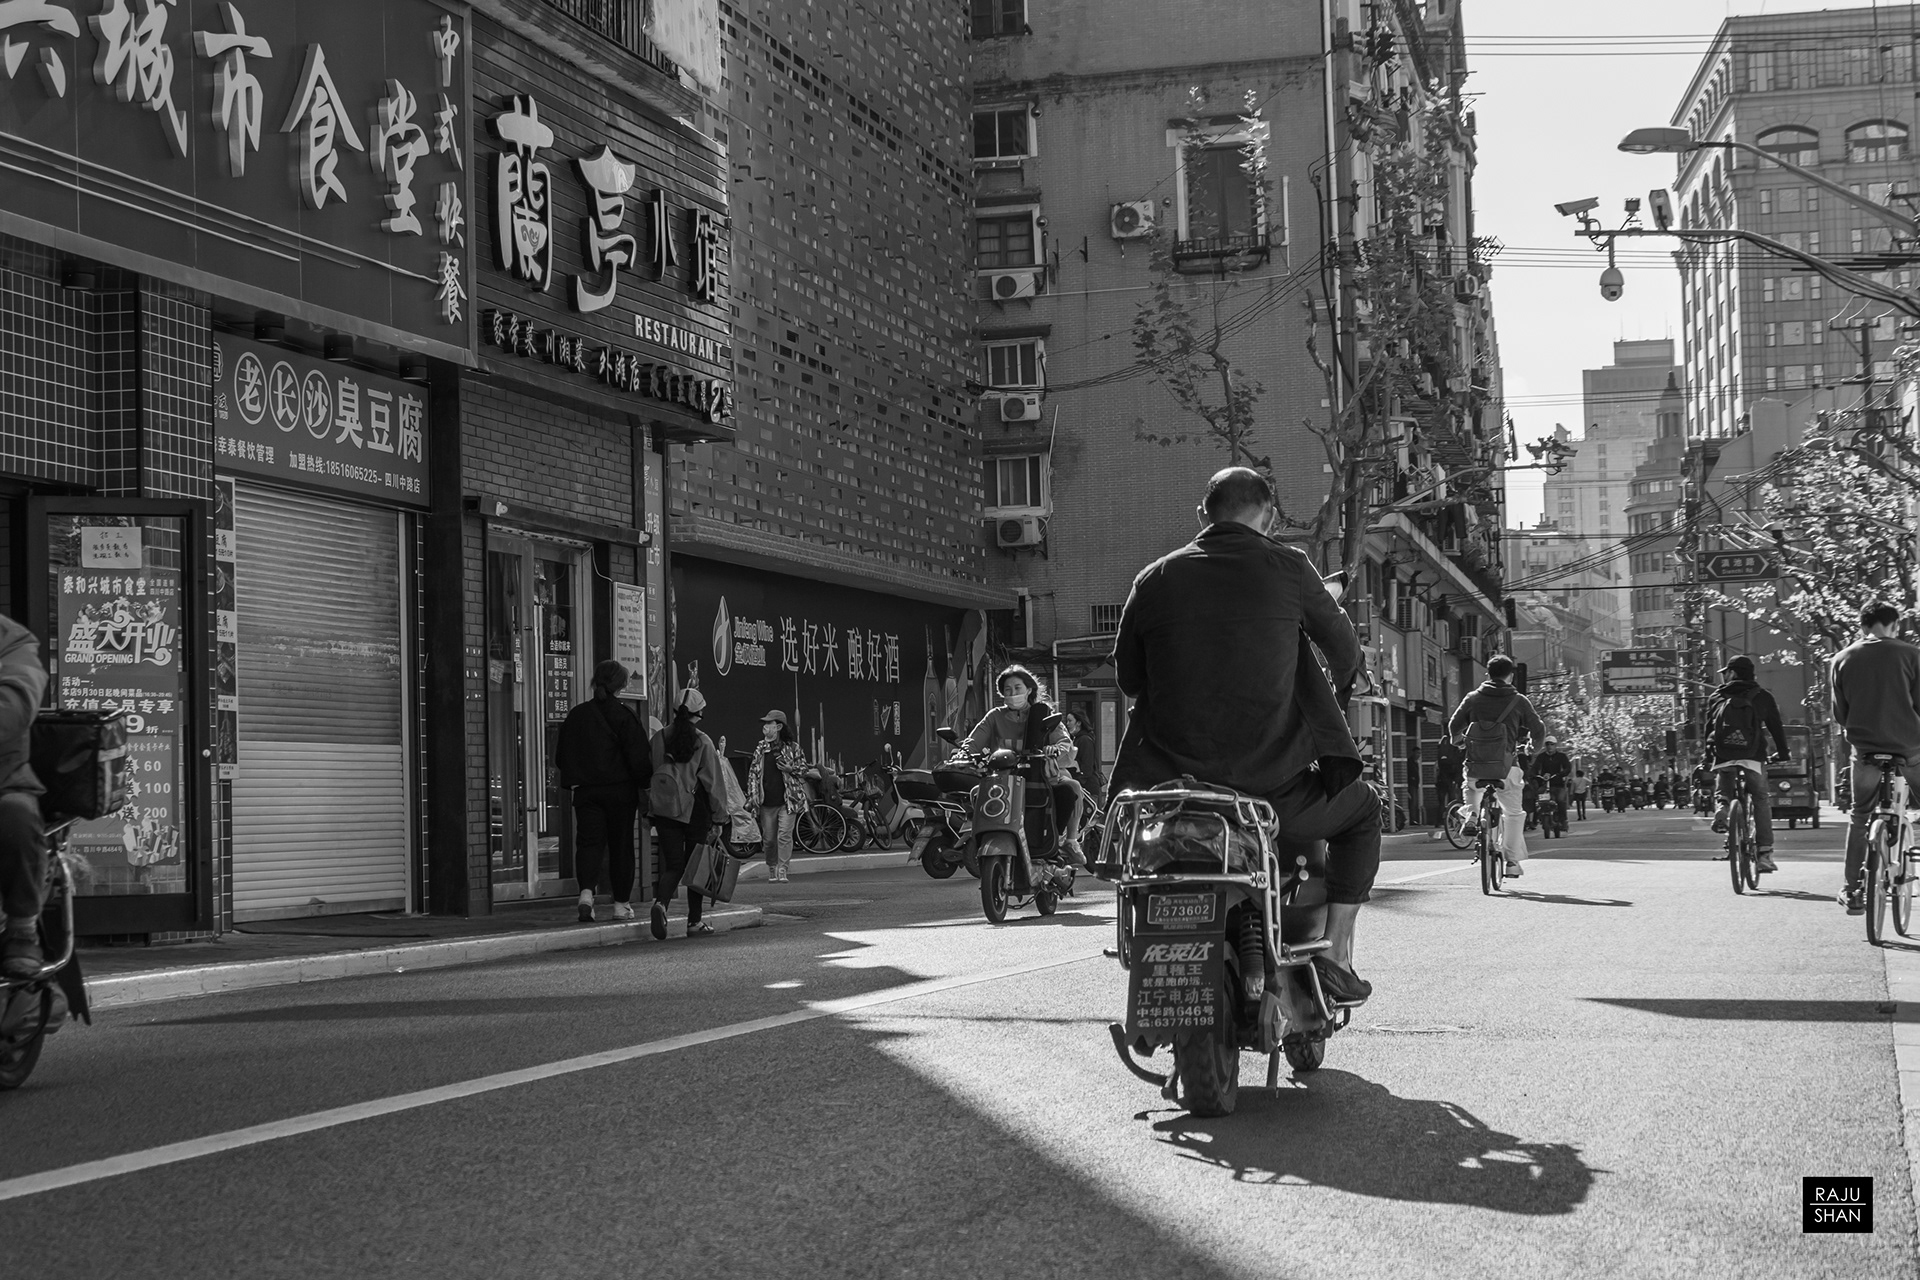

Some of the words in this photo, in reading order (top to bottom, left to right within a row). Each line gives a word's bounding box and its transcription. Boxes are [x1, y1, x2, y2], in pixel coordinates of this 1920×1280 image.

[635, 314, 723, 364] RESTAURANT
[235, 352, 424, 465] 老长沙臭豆腐
[63, 575, 147, 596] 泰和兴城市食堂
[779, 616, 840, 678] 选好米
[846, 626, 900, 684] 酿好酒
[64, 653, 94, 664] GRAND
[96, 653, 134, 664] OPENING
[144, 760, 162, 771] 60
[144, 782, 171, 794] 100
[143, 807, 168, 819] 200
[1154, 904, 1210, 917] 7573602
[1137, 987, 1215, 1006] 江宁电动车
[1136, 1005, 1215, 1018] 中华路646号
